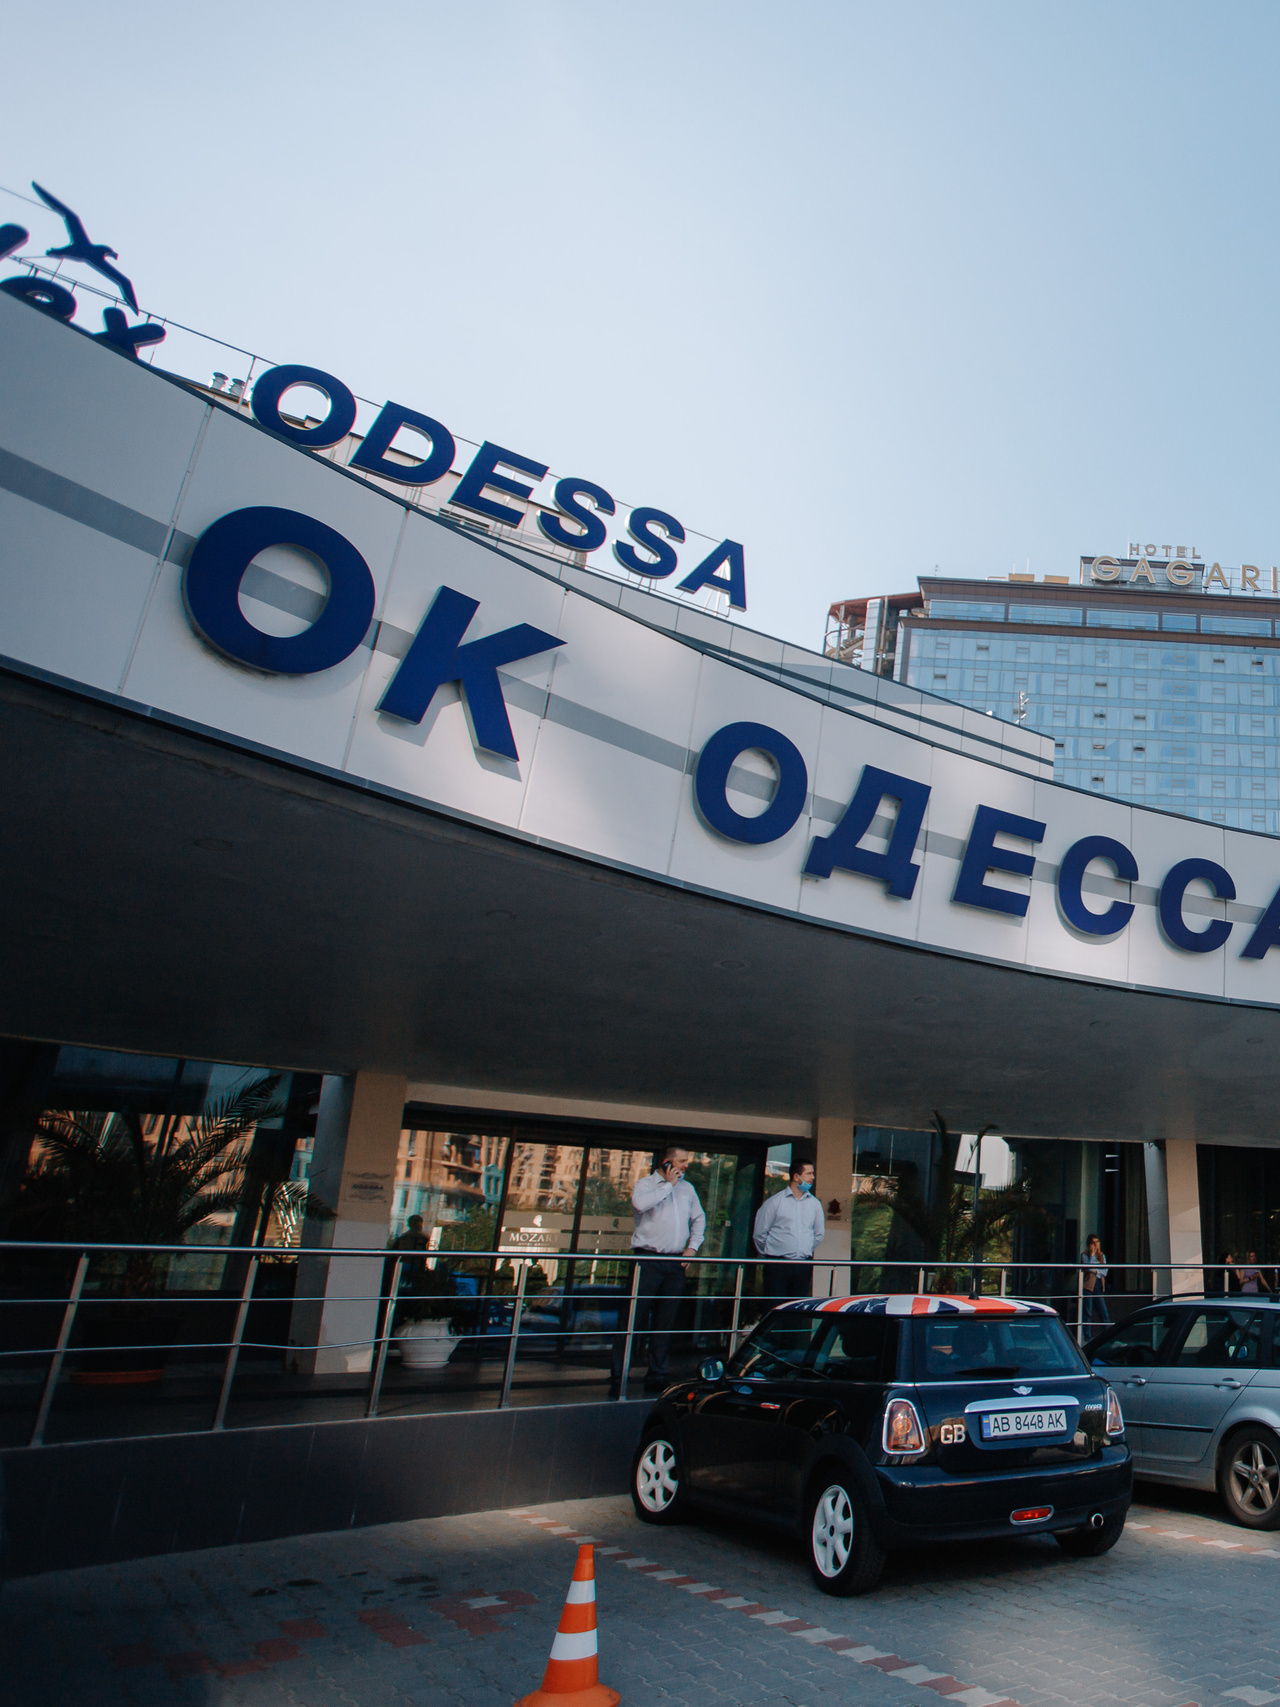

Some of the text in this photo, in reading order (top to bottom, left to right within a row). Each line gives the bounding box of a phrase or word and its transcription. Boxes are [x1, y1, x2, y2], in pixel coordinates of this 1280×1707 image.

[250, 364, 747, 613] ODESSA
[1129, 543, 1201, 559] HOTEL
[992, 1413, 1064, 1433] AB 8448 AK
[940, 1424, 966, 1444] GB
